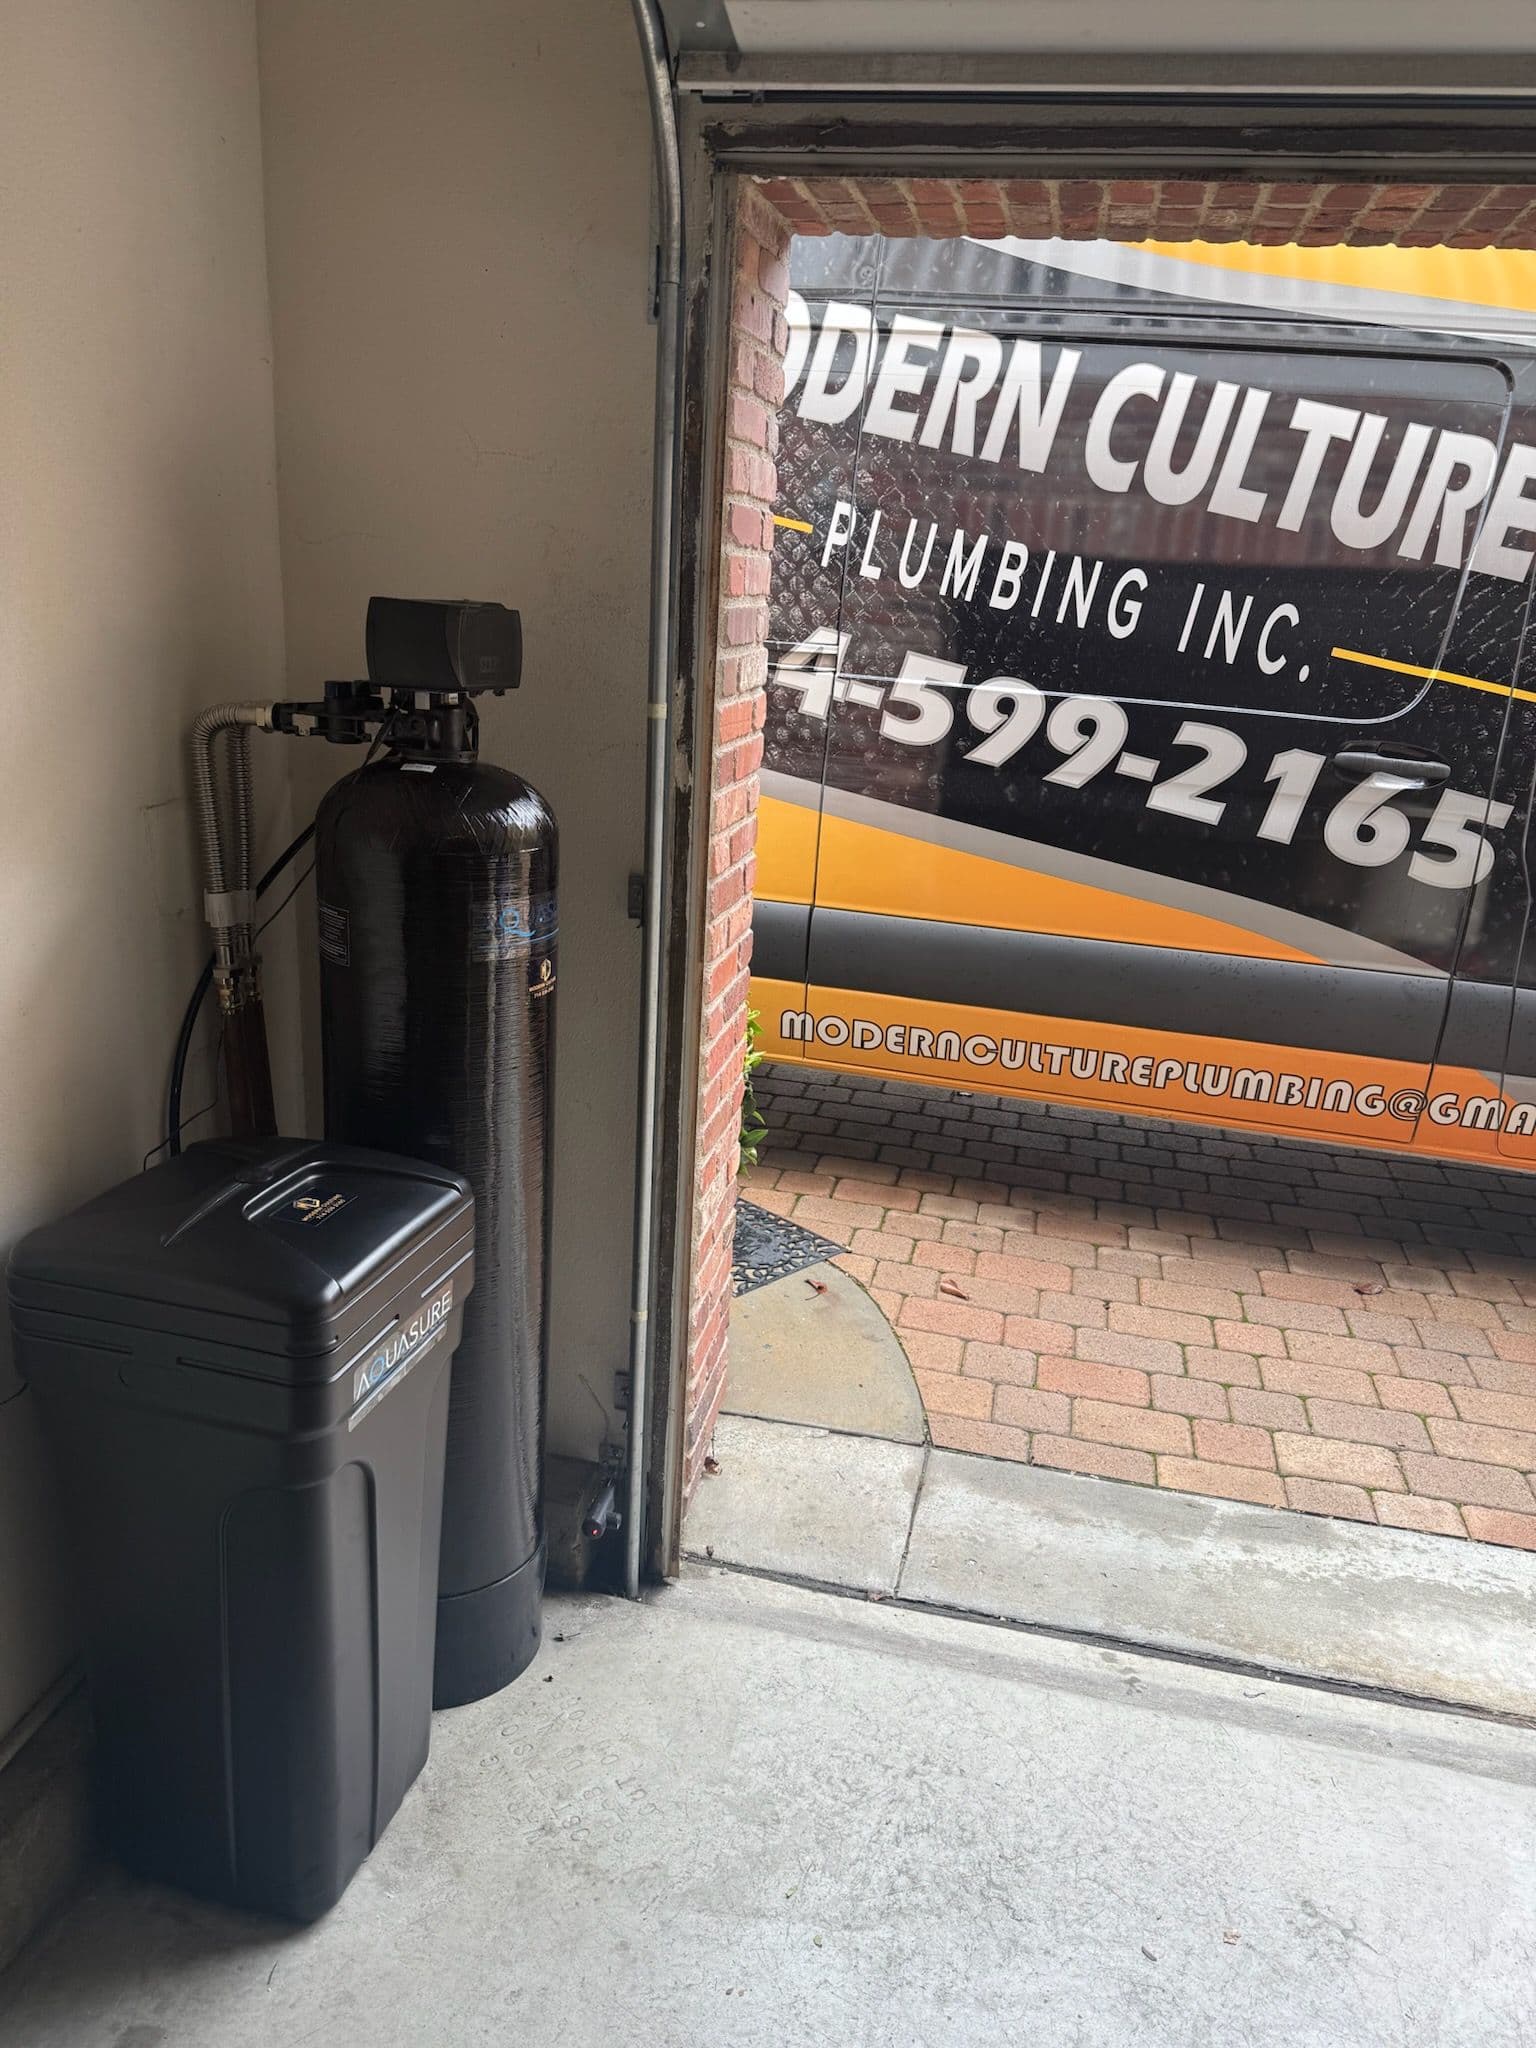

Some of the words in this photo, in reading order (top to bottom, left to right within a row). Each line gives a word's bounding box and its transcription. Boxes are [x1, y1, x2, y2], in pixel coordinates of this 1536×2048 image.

[1084, 362, 1536, 583] CULTURE
[821, 500, 1149, 640] PLUMBING
[1177, 582, 1311, 684] INC.
[773, 626, 1515, 889] 4-599-2165
[780, 1009, 1536, 1136] MODERNCULTUREPLUMBING@GMA
[353, 1290, 451, 1403] AQUASURE
